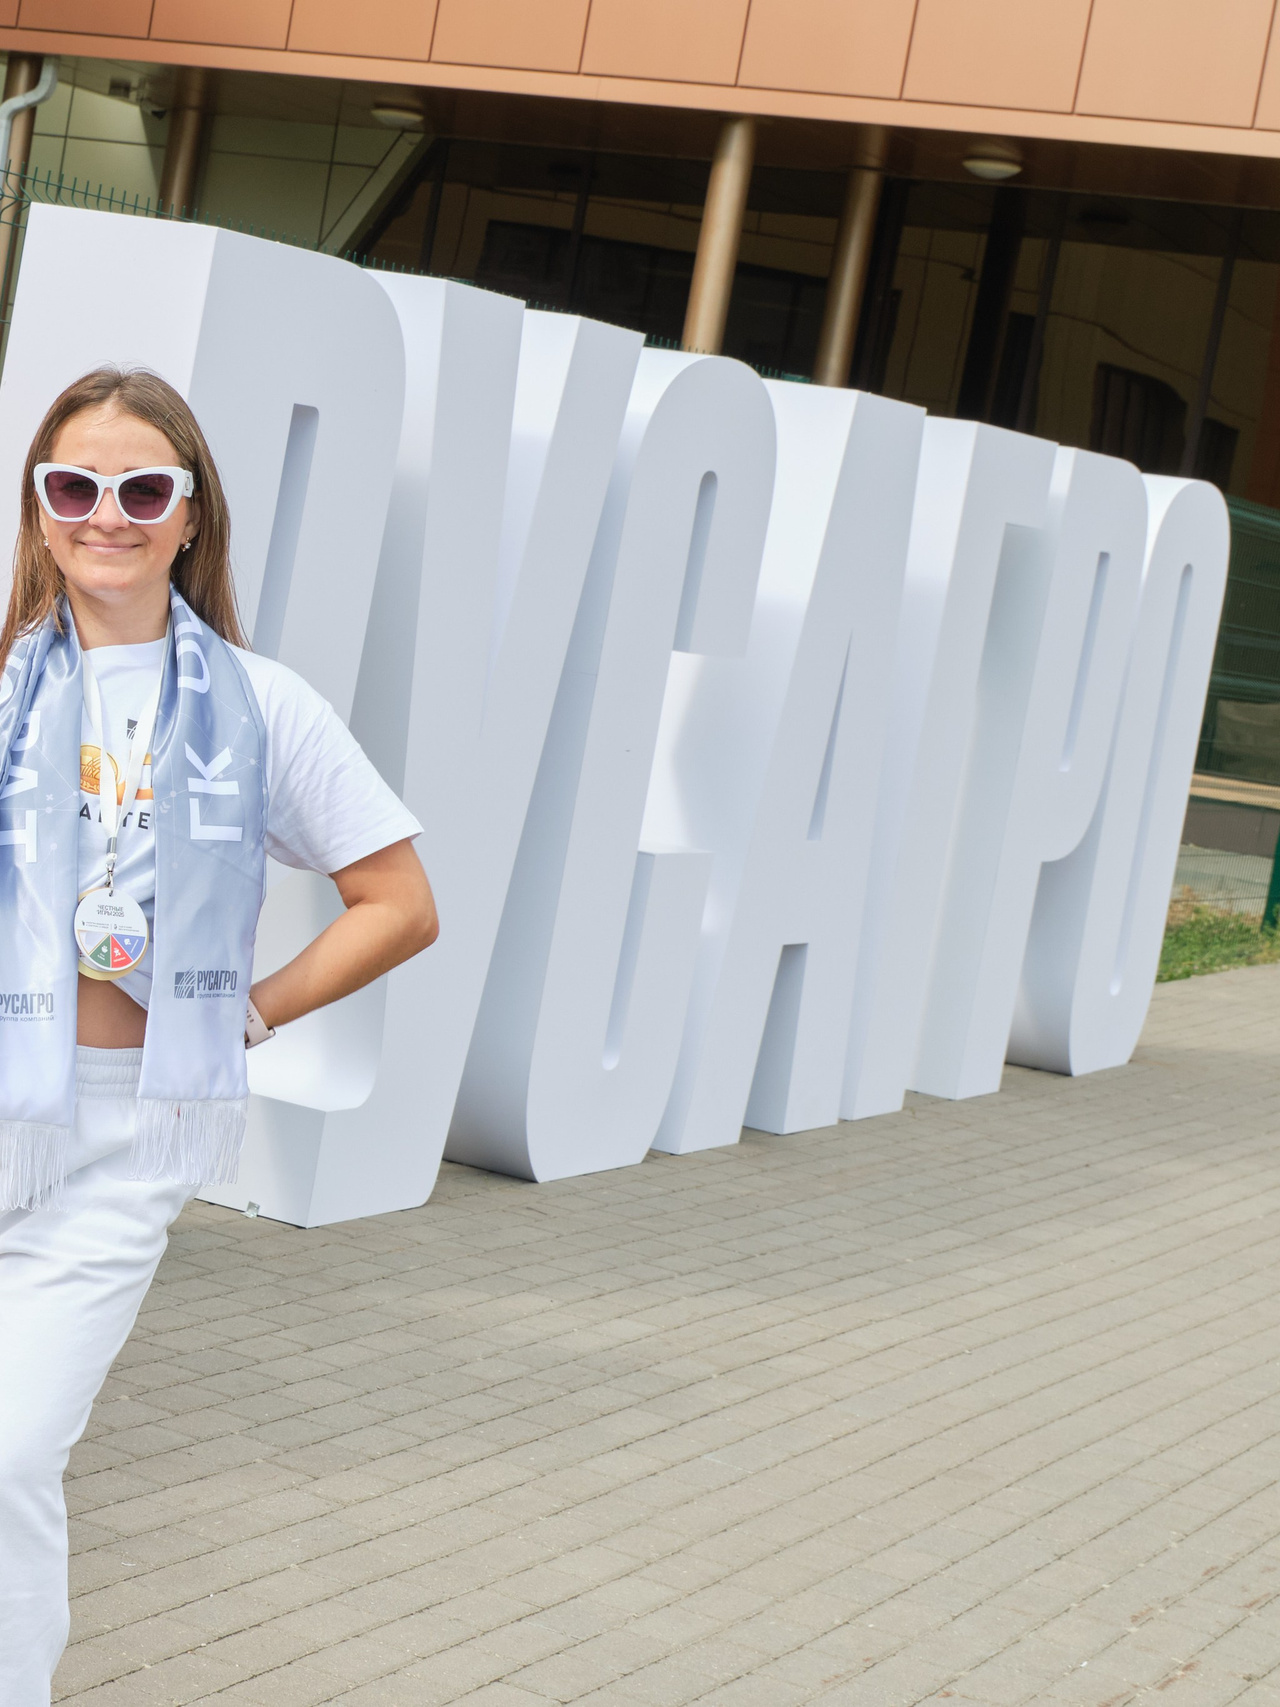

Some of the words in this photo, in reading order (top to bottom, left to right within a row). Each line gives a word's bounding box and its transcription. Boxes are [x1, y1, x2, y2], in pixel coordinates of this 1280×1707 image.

[184, 741, 243, 842] ГК
[97, 904, 124, 912] ЧЕСТНЫЕ
[196, 970, 238, 991] РУСАГРО
[20, 1014, 55, 1022] компаний
